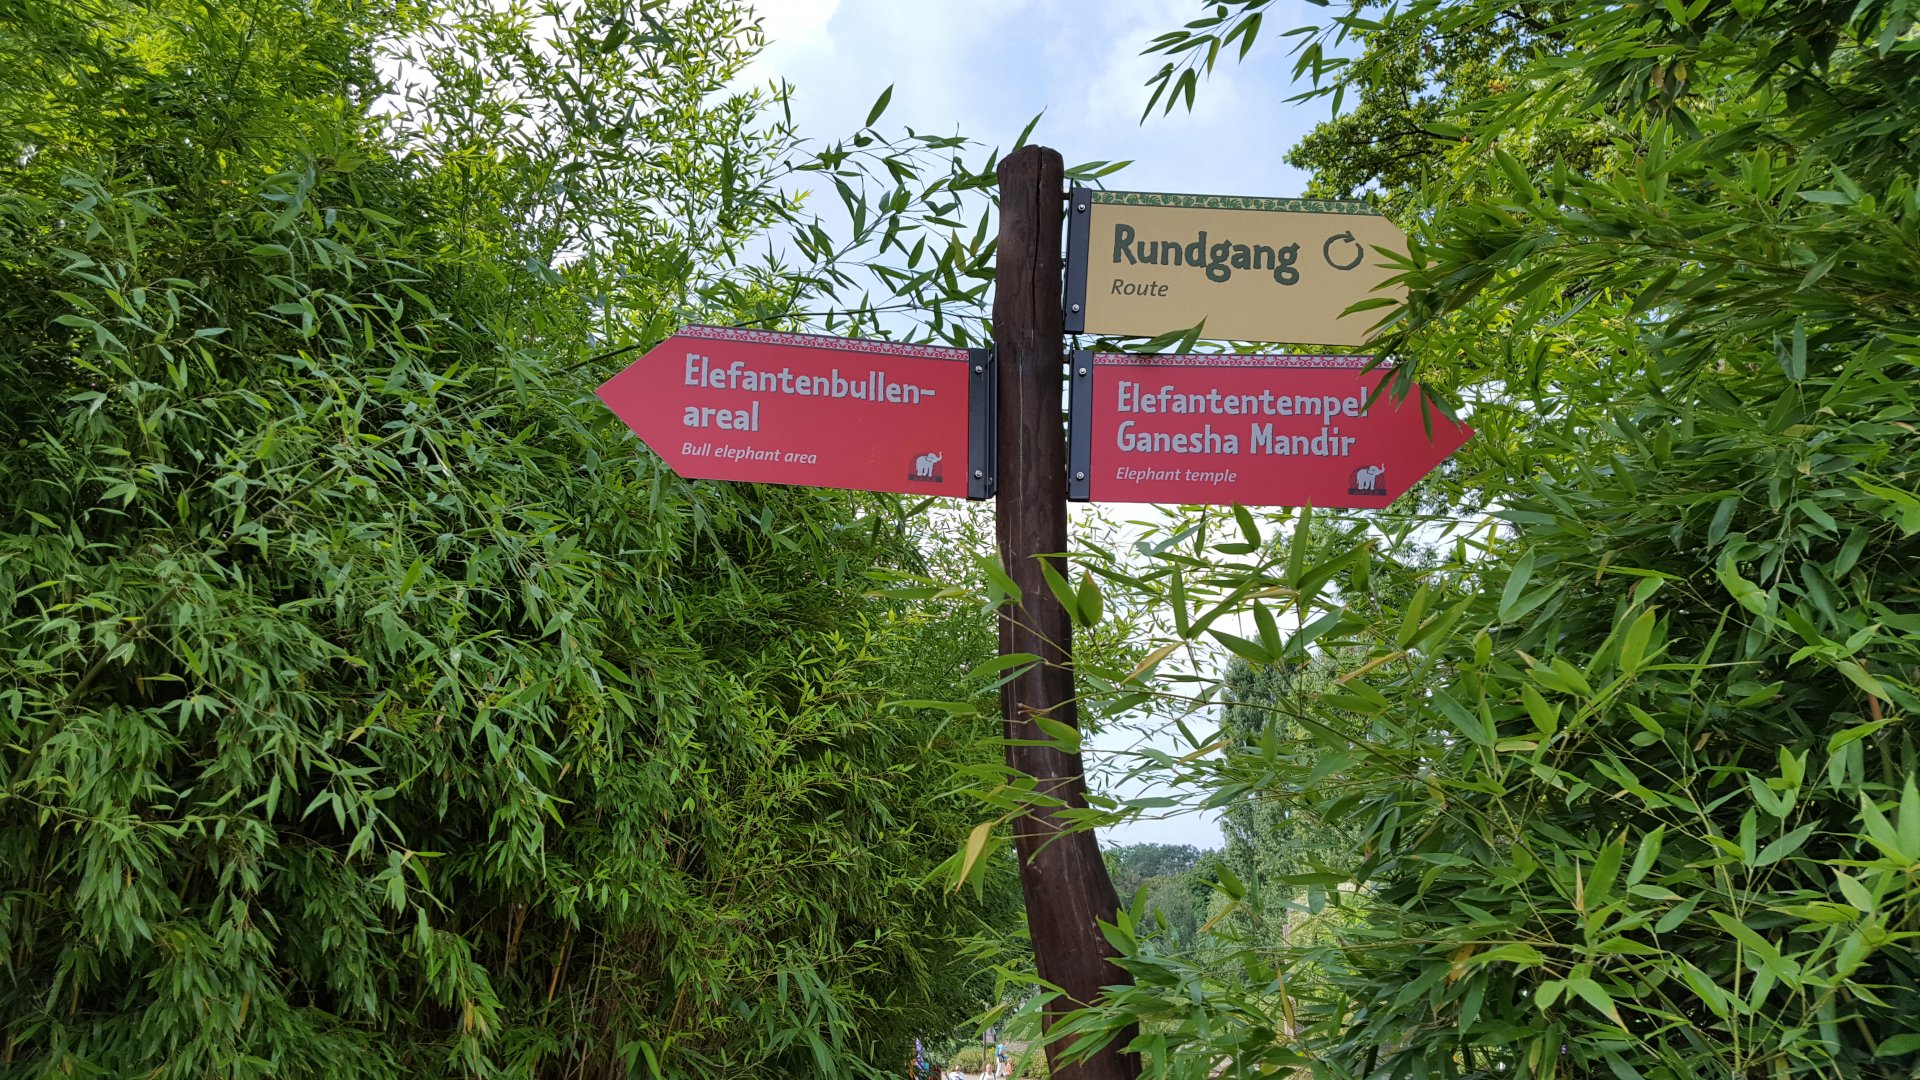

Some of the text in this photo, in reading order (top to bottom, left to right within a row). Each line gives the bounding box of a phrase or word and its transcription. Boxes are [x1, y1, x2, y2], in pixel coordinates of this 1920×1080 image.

[1113, 224, 1300, 286] Rundgang
[1111, 279, 1169, 297] Route
[684, 352, 937, 405] Elefantenbullen-
[683, 401, 759, 432] areal
[1117, 380, 1368, 426] Elefantentempel
[681, 442, 817, 465] Bull elephant area
[1117, 420, 1356, 457] Ganesha Mandir
[1116, 466, 1237, 486] Elephant temple
